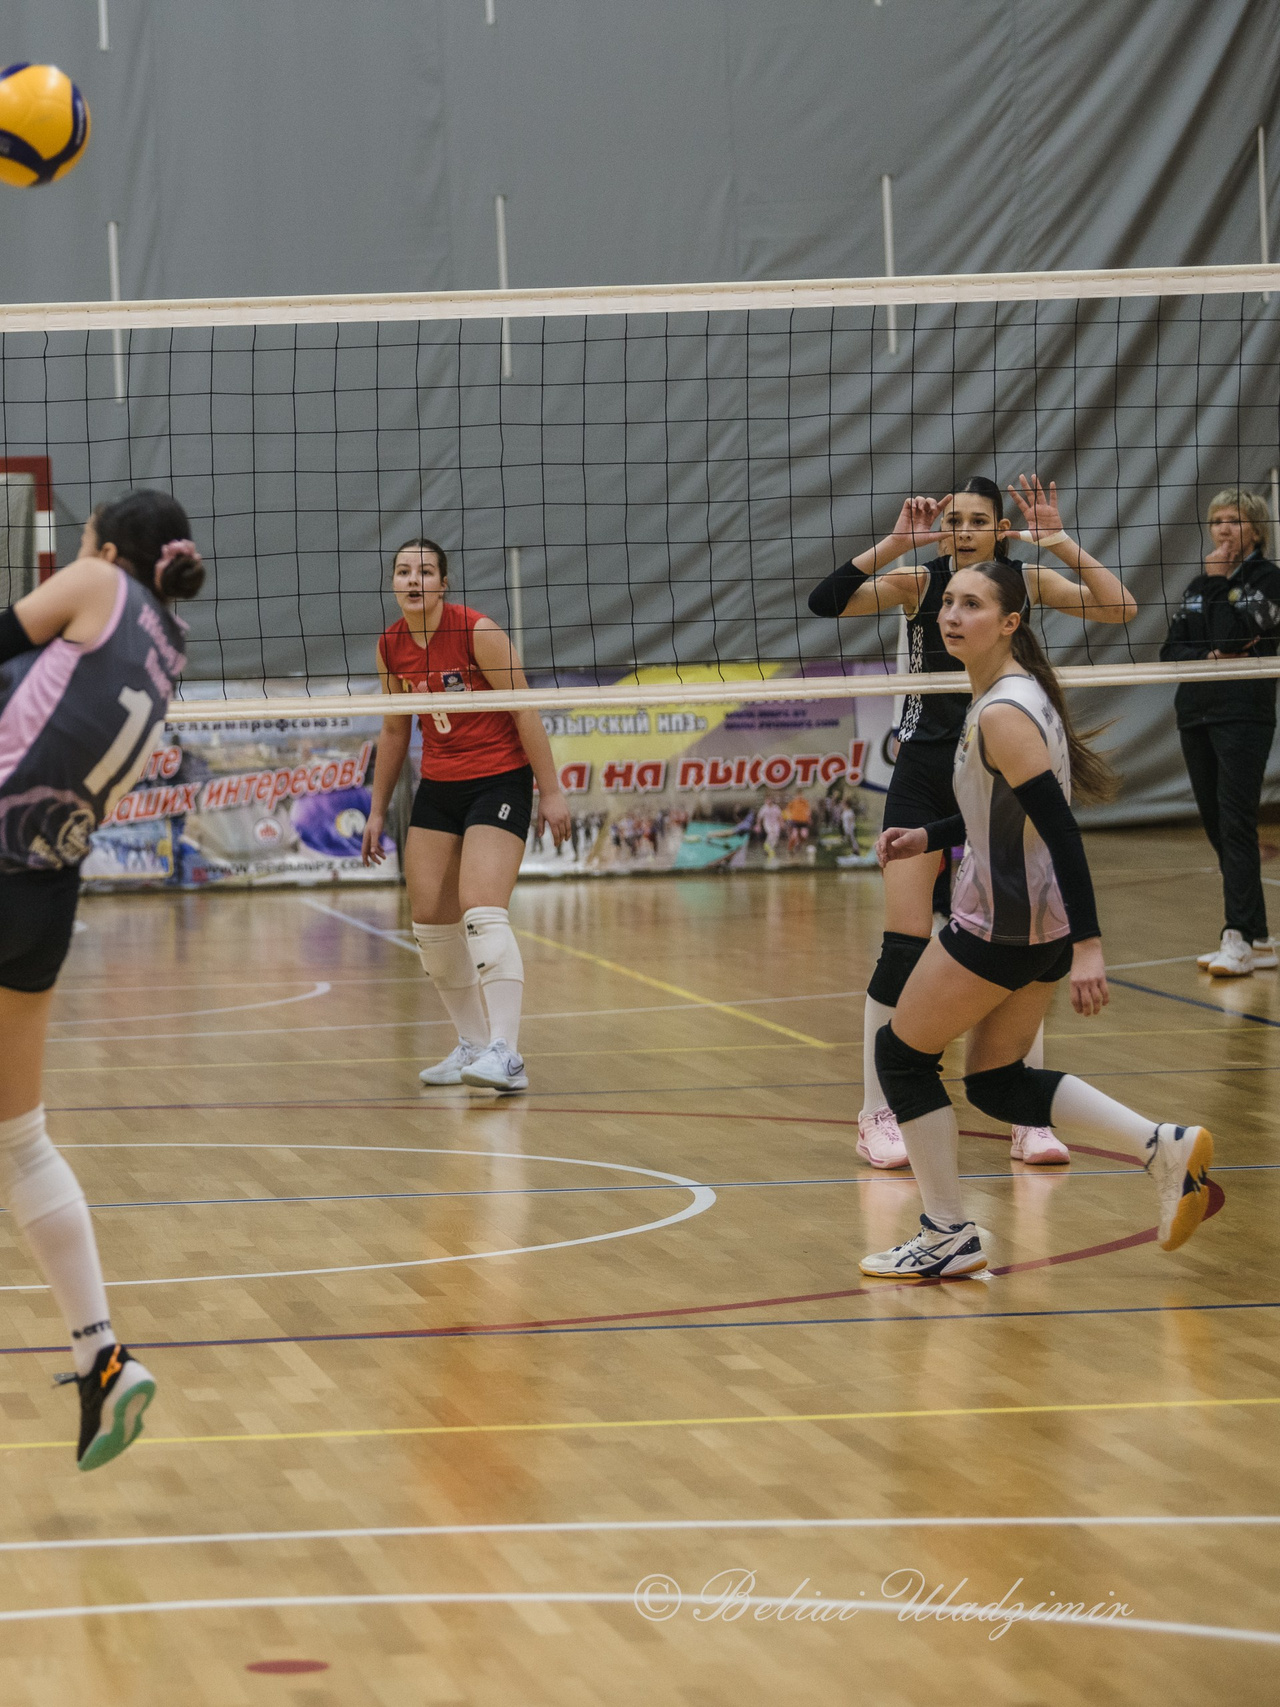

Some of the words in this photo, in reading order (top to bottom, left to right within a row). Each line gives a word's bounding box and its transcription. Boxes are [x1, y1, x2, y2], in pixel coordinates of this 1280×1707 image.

[541, 706, 650, 735] ОЗЫРСКИЙ
[203, 741, 373, 811] интересов!
[602, 760, 666, 793] на
[677, 740, 868, 791] высоте!
[498, 803, 511, 820] 9
